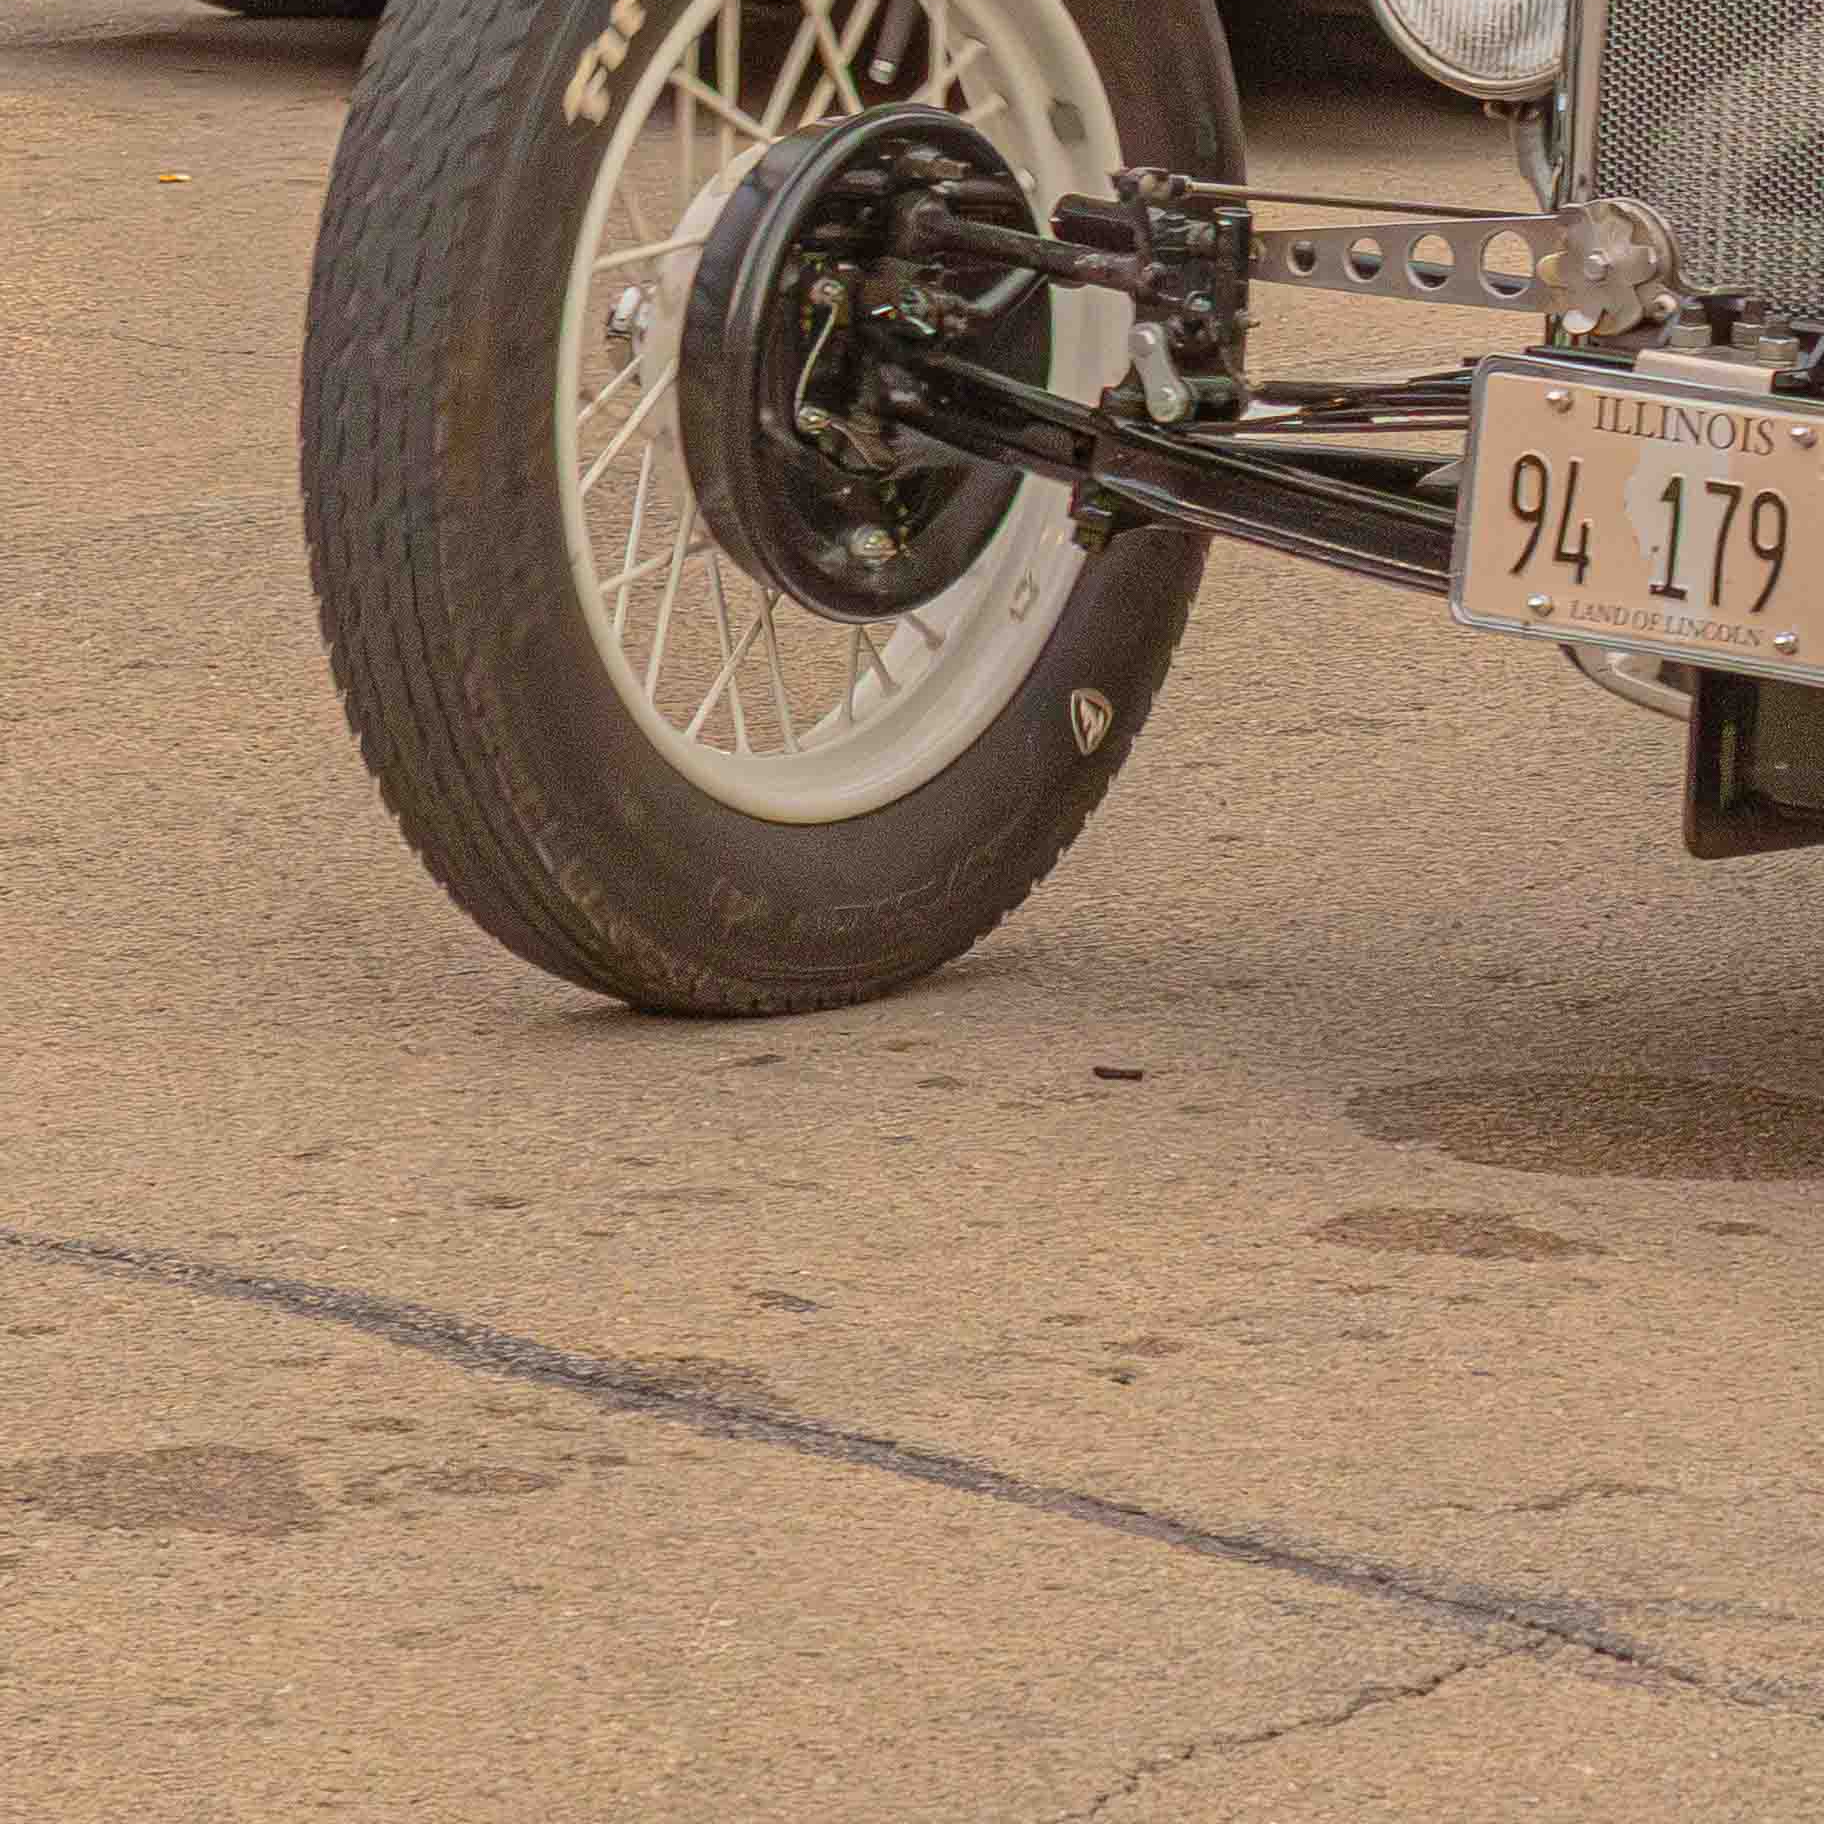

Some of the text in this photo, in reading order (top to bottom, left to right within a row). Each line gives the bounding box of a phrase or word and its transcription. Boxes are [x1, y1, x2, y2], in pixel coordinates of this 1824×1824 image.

[1591, 393, 1776, 457] ILLINOIS
[1508, 453, 1789, 614] 94 179
[1569, 599, 1766, 648] LAND OF LINCOLN
